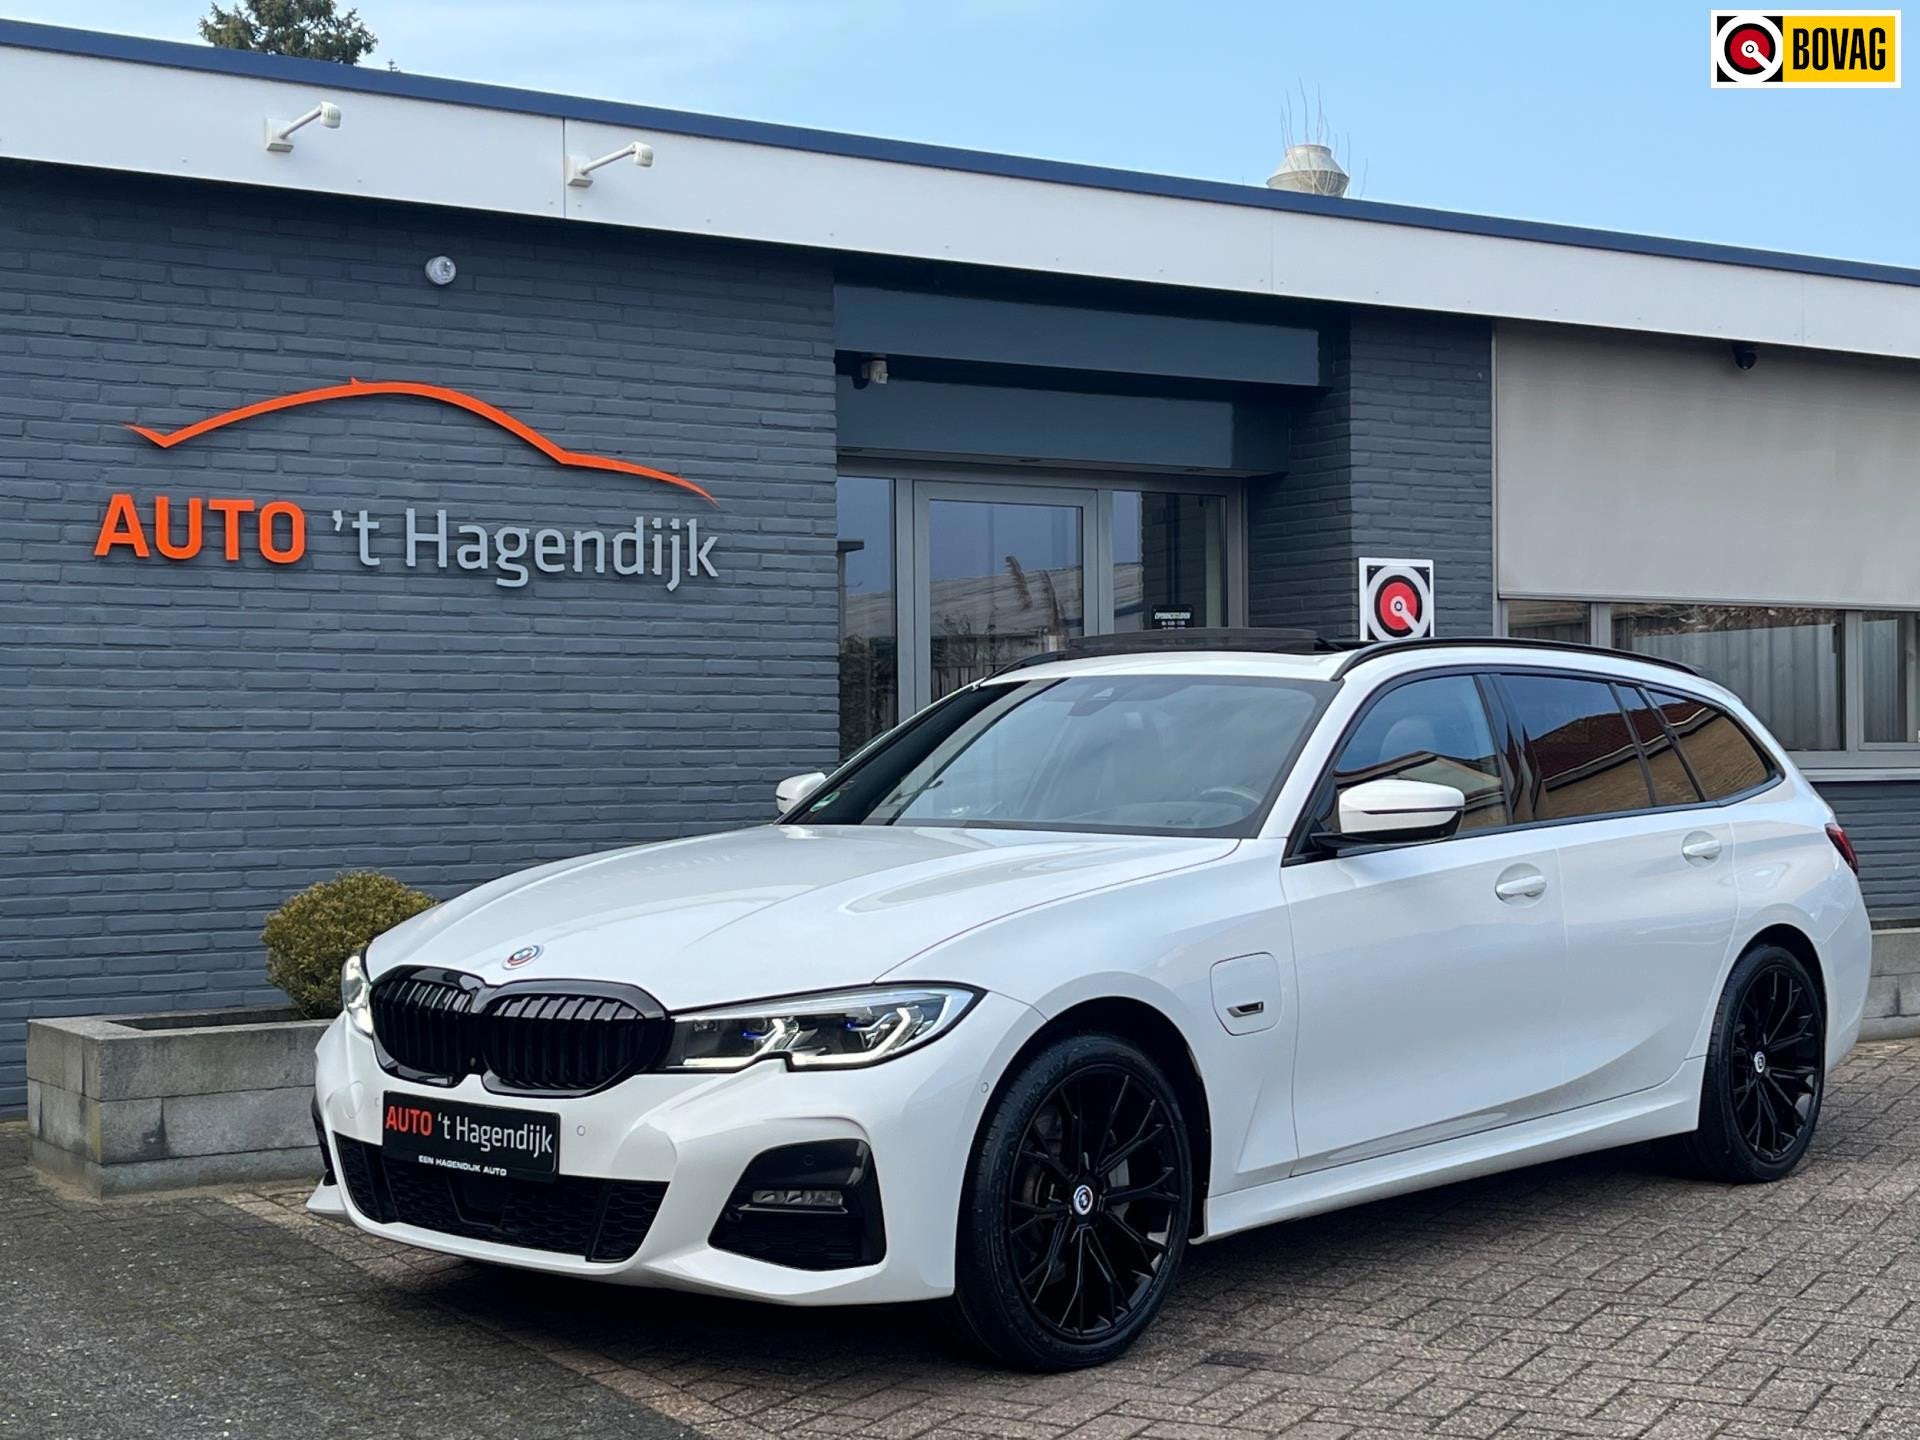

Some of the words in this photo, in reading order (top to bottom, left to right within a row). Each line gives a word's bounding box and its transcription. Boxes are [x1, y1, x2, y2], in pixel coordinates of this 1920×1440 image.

[95, 493, 305, 563] AUTO
[332, 509, 381, 566] 't
[406, 508, 720, 592] Hagendijk
[386, 1105, 432, 1136] AUTO
[456, 1115, 553, 1158] Hagendijk
[418, 1155, 434, 1164] EEN
[436, 1158, 481, 1172] HAGENDIJK
[483, 1166, 507, 1176] AUTO
